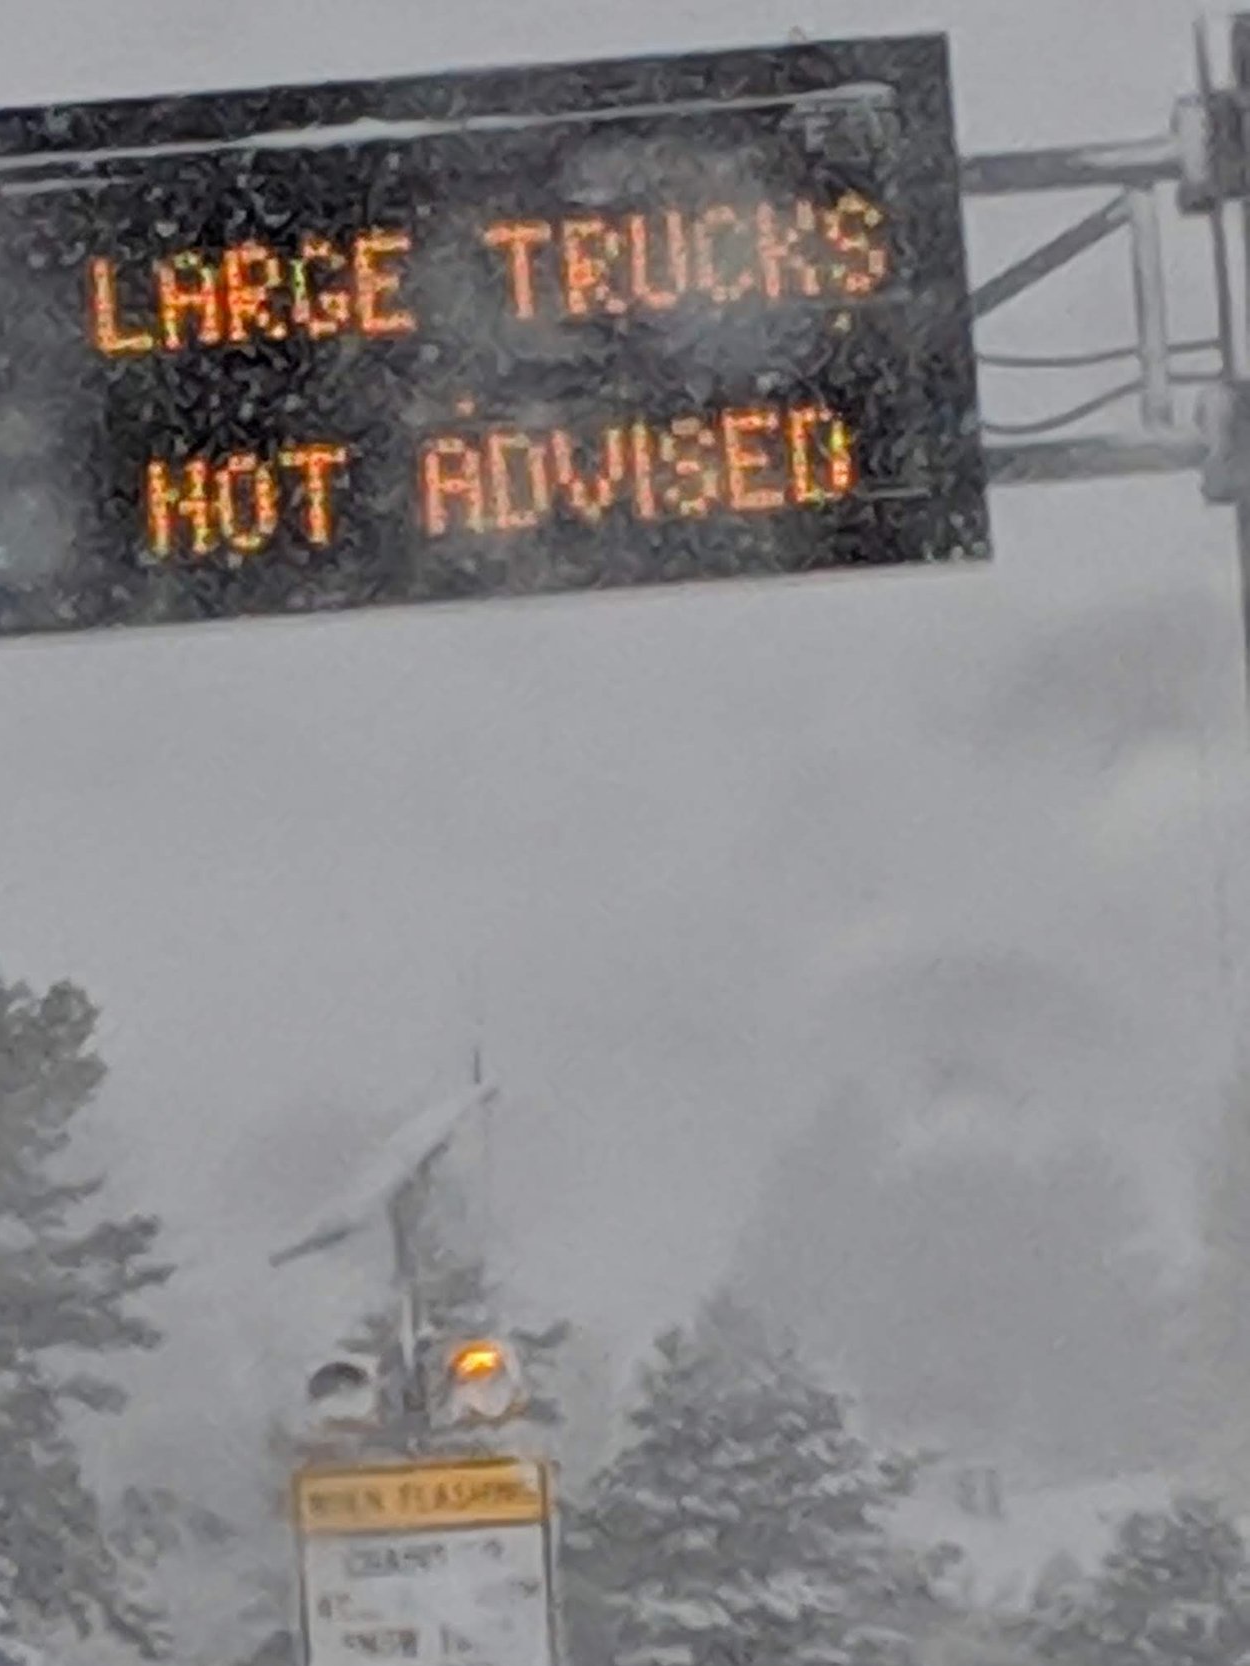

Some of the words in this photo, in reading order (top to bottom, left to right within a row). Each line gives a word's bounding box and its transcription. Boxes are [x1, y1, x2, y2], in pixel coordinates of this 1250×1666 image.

[88, 226, 417, 356] LARGE
[482, 189, 890, 320] TRUCKS
[144, 441, 351, 562] NOT
[420, 404, 857, 534] ADVISED
